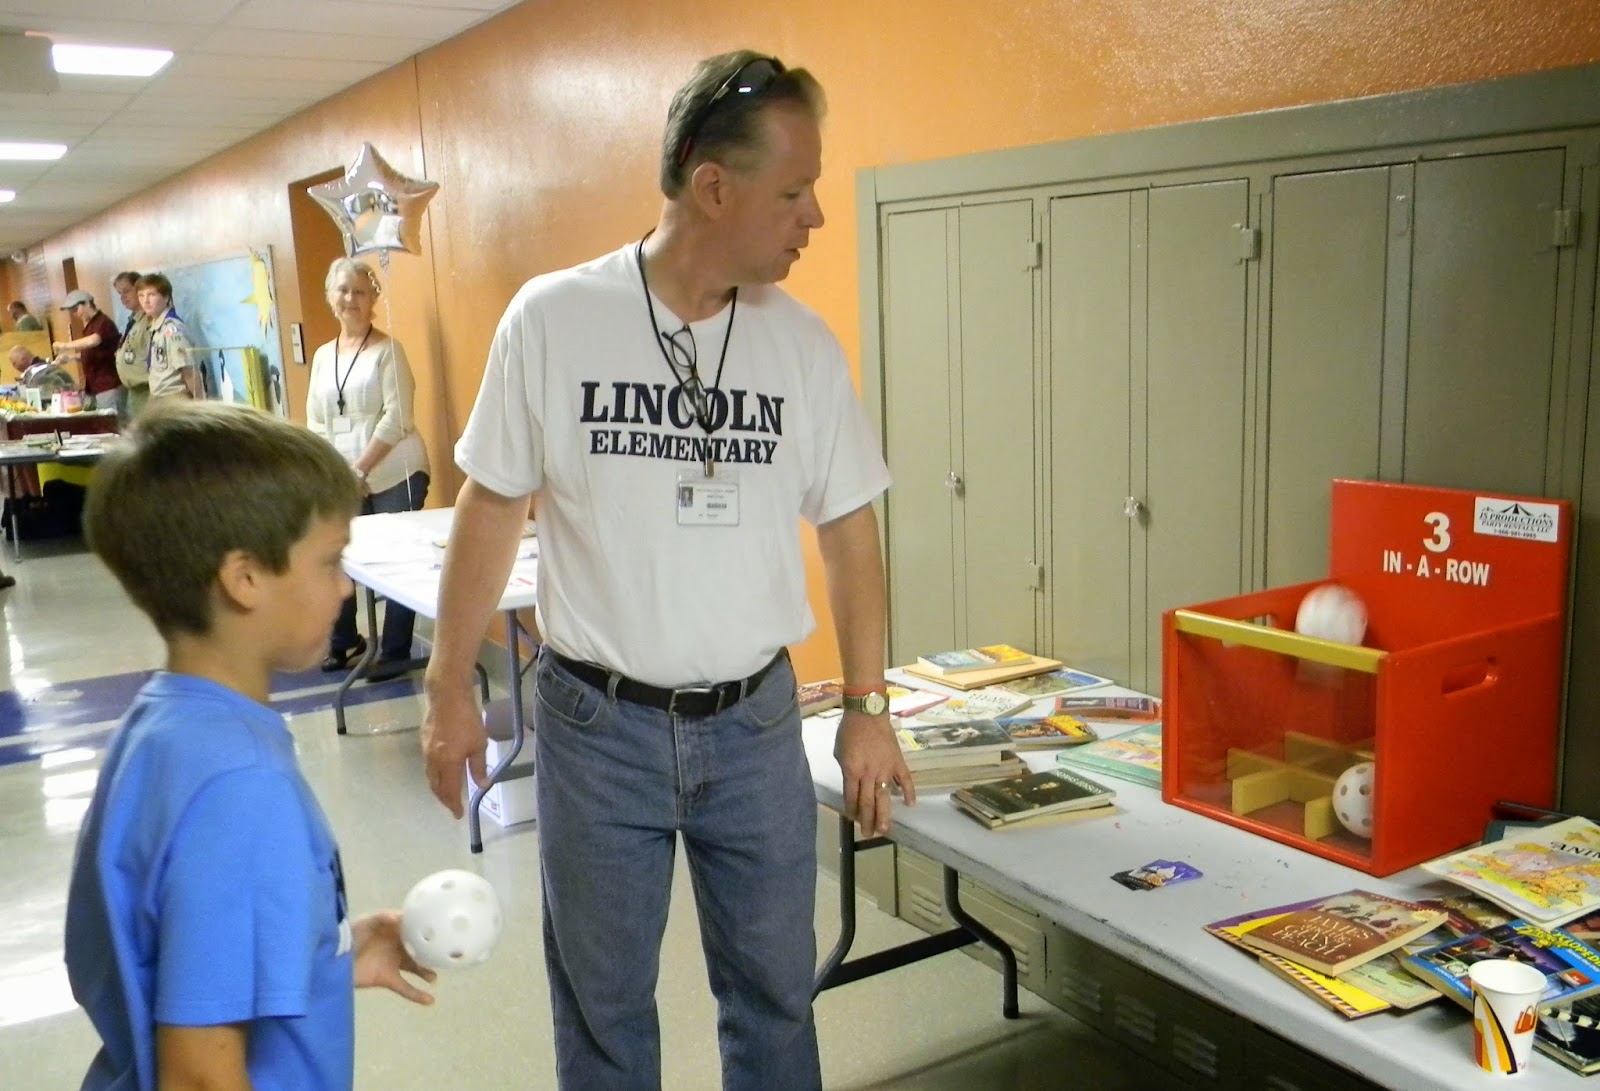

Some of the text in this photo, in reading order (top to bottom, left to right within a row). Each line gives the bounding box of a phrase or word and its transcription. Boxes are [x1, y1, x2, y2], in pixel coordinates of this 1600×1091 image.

[580, 381, 785, 436] LINCOLN
[590, 430, 778, 465] ELEMENTARY
[1423, 511, 1451, 553] 3
[1489, 513, 1553, 527] PRODUCTIONS
[1446, 558, 1490, 587] ROW
